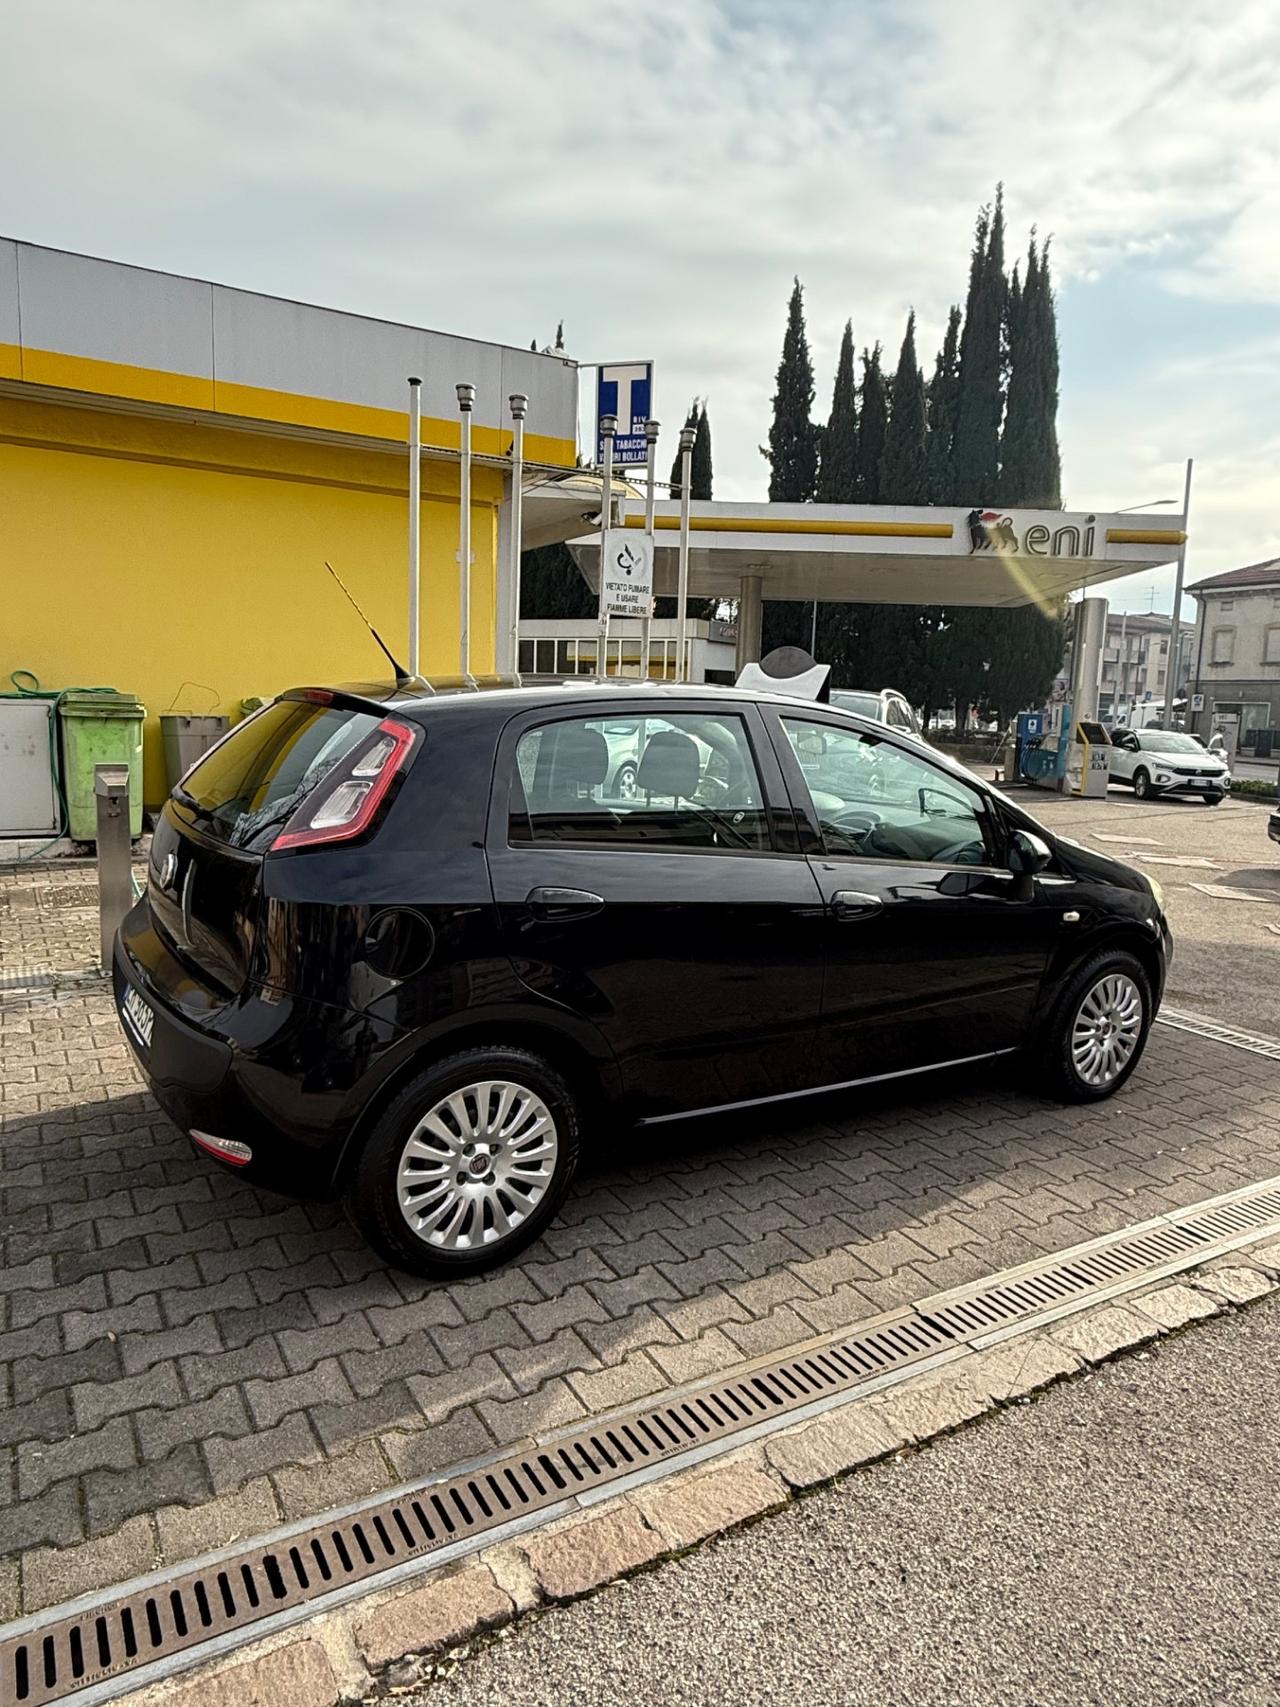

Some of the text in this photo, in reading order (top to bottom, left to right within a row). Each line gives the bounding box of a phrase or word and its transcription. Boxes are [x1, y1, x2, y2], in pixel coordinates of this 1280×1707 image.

[603, 365, 647, 435] T
[1025, 514, 1096, 556] eni
[606, 582, 650, 594] VIETATO FUMARE
[616, 593, 639, 603] E USARE
[607, 603, 647, 615] FIAMME LIBERE
